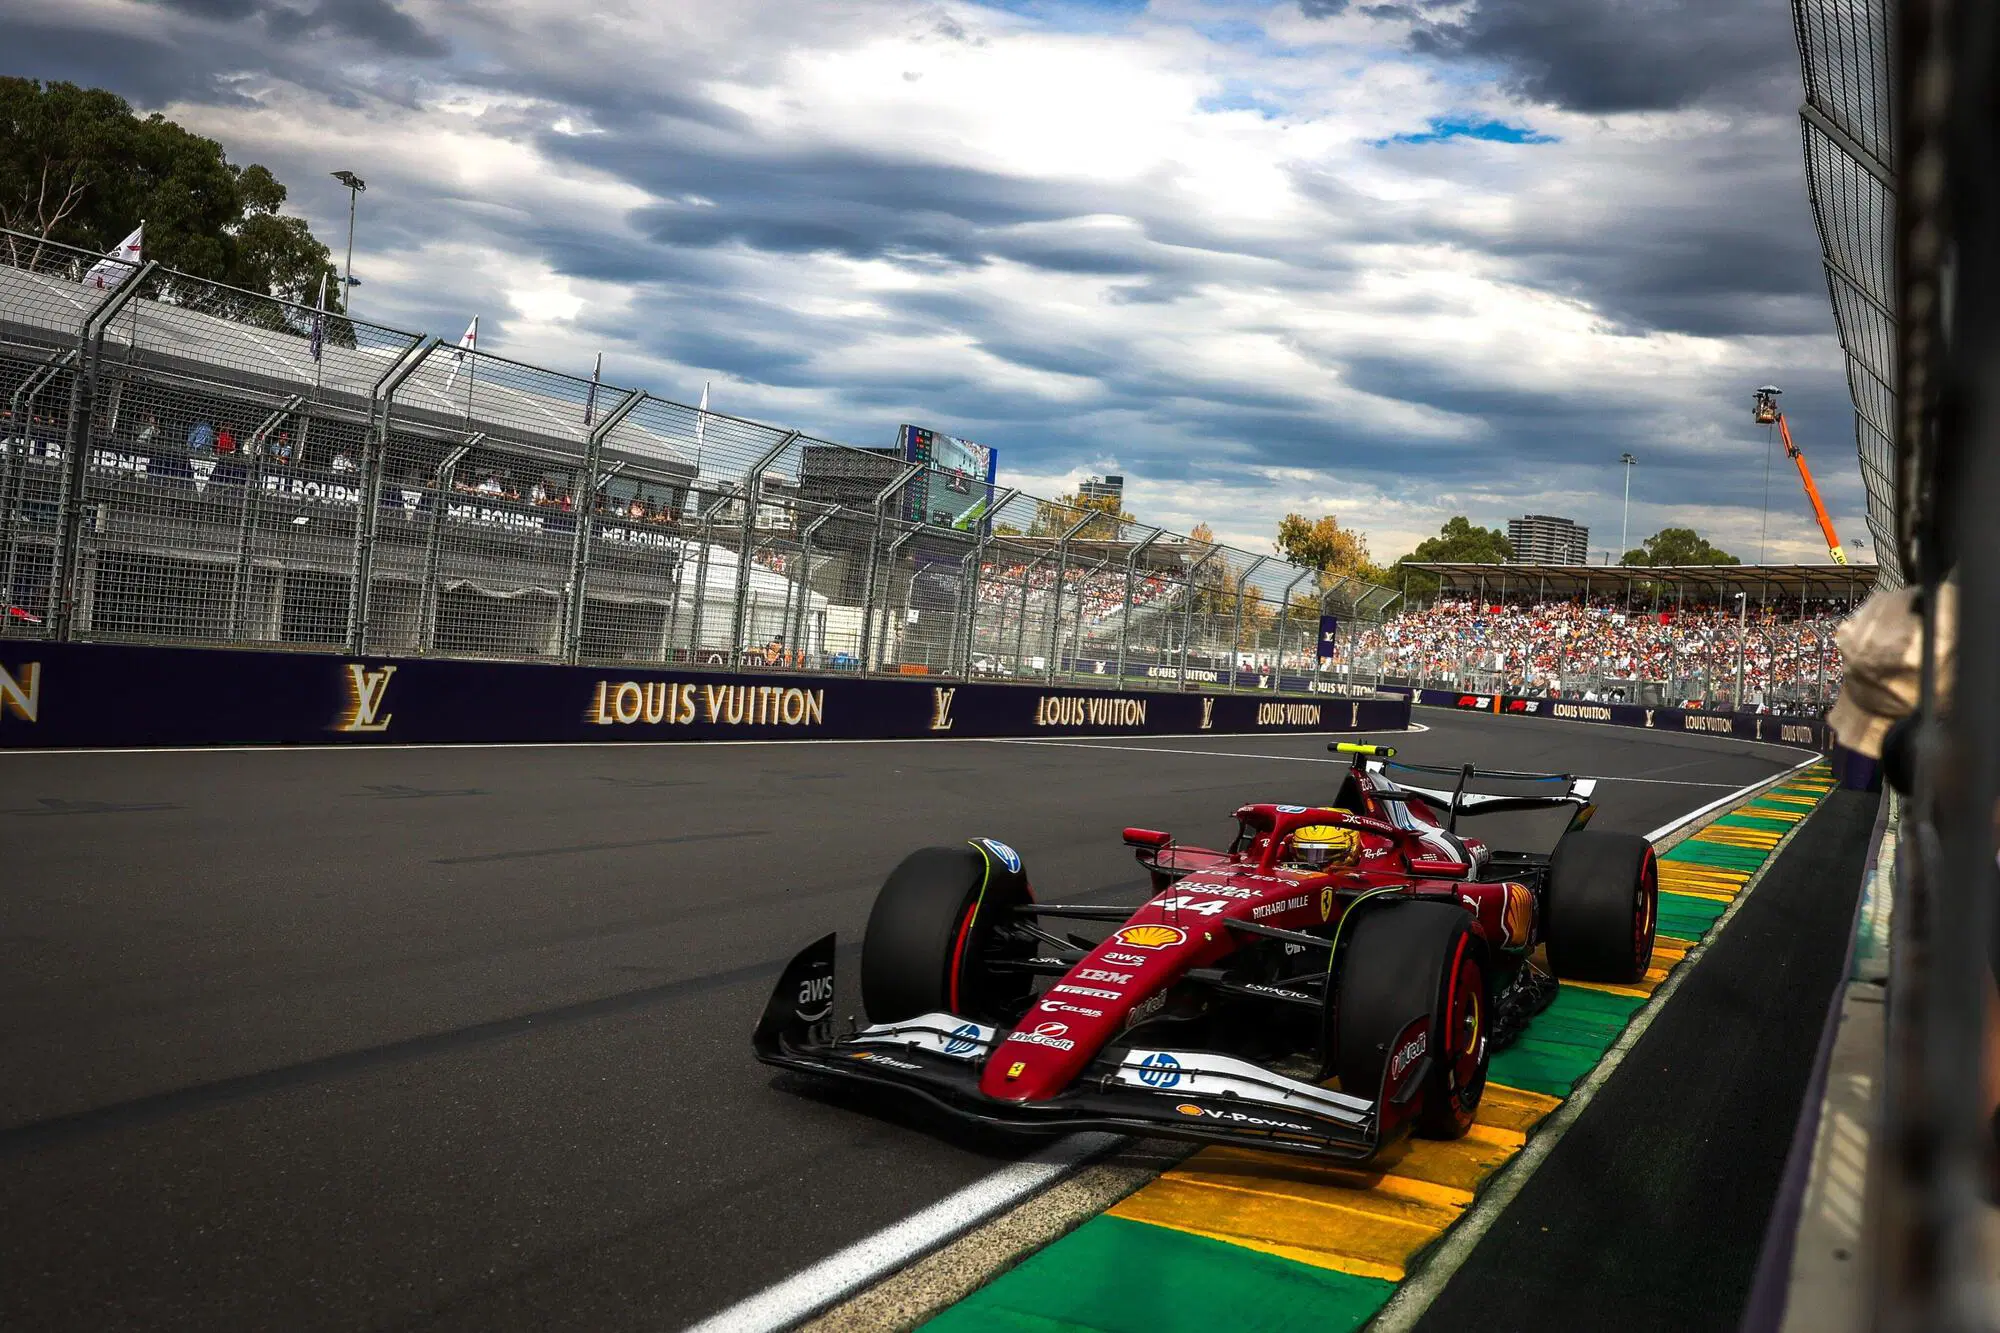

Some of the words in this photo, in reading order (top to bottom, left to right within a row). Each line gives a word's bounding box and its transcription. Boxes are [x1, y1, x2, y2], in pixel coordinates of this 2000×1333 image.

[596, 680, 697, 726] LOUIS
[706, 684, 824, 726] VUITTON
[1037, 696, 1085, 726] LOUIS
[1088, 697, 1147, 726] VUITTON
[1554, 704, 1578, 718] LOUIS
[1579, 706, 1612, 720] VUITTON
[1258, 703, 1285, 725] LOUIS
[1286, 704, 1321, 725] VUITTON
[1685, 714, 1706, 731] LOUIS
[1174, 881, 1264, 897] GLOBAL
[1150, 895, 1230, 916] 44
[1253, 900, 1287, 919] RICHARD
[1287, 895, 1309, 911] MILLE
[1103, 951, 1147, 964] aws
[1075, 968, 1134, 985] IBM
[800, 975, 833, 1004] aws
[1053, 984, 1122, 1000] PIRELLI
[1007, 1031, 1075, 1051] UniCredit
[1142, 1053, 1179, 1089] hp
[1204, 1108, 1312, 1131] V-Power
